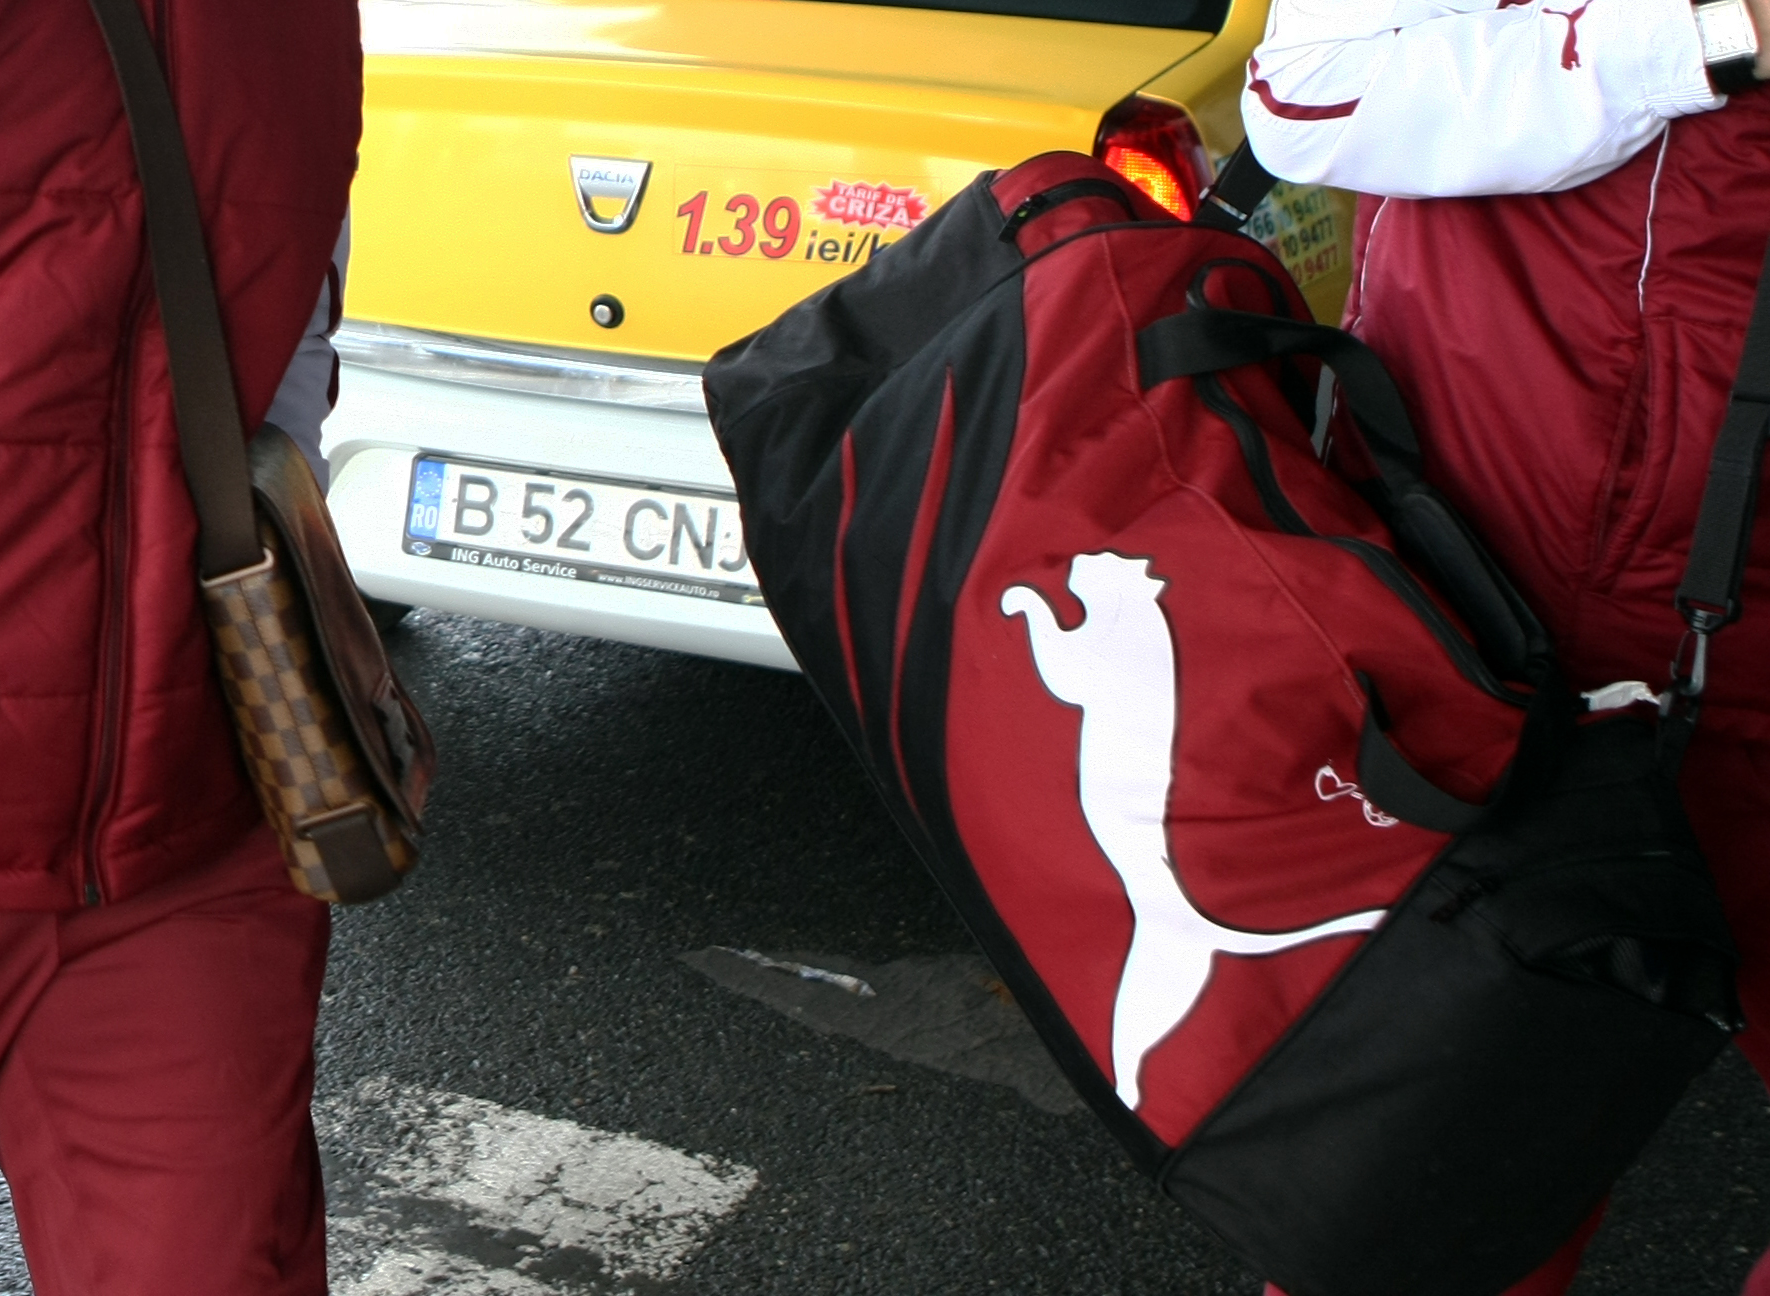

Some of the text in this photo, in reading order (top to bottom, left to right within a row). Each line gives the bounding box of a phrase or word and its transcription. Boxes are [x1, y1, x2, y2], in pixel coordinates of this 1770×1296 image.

[578, 168, 634, 184] DACIA
[837, 183, 907, 206] TARIF DE
[676, 190, 802, 259] 1.39
[830, 195, 911, 226] CRIZA
[410, 503, 438, 530] RO
[453, 473, 499, 536] B
[520, 482, 595, 551] 52
[450, 547, 578, 579] ING Auto Service
